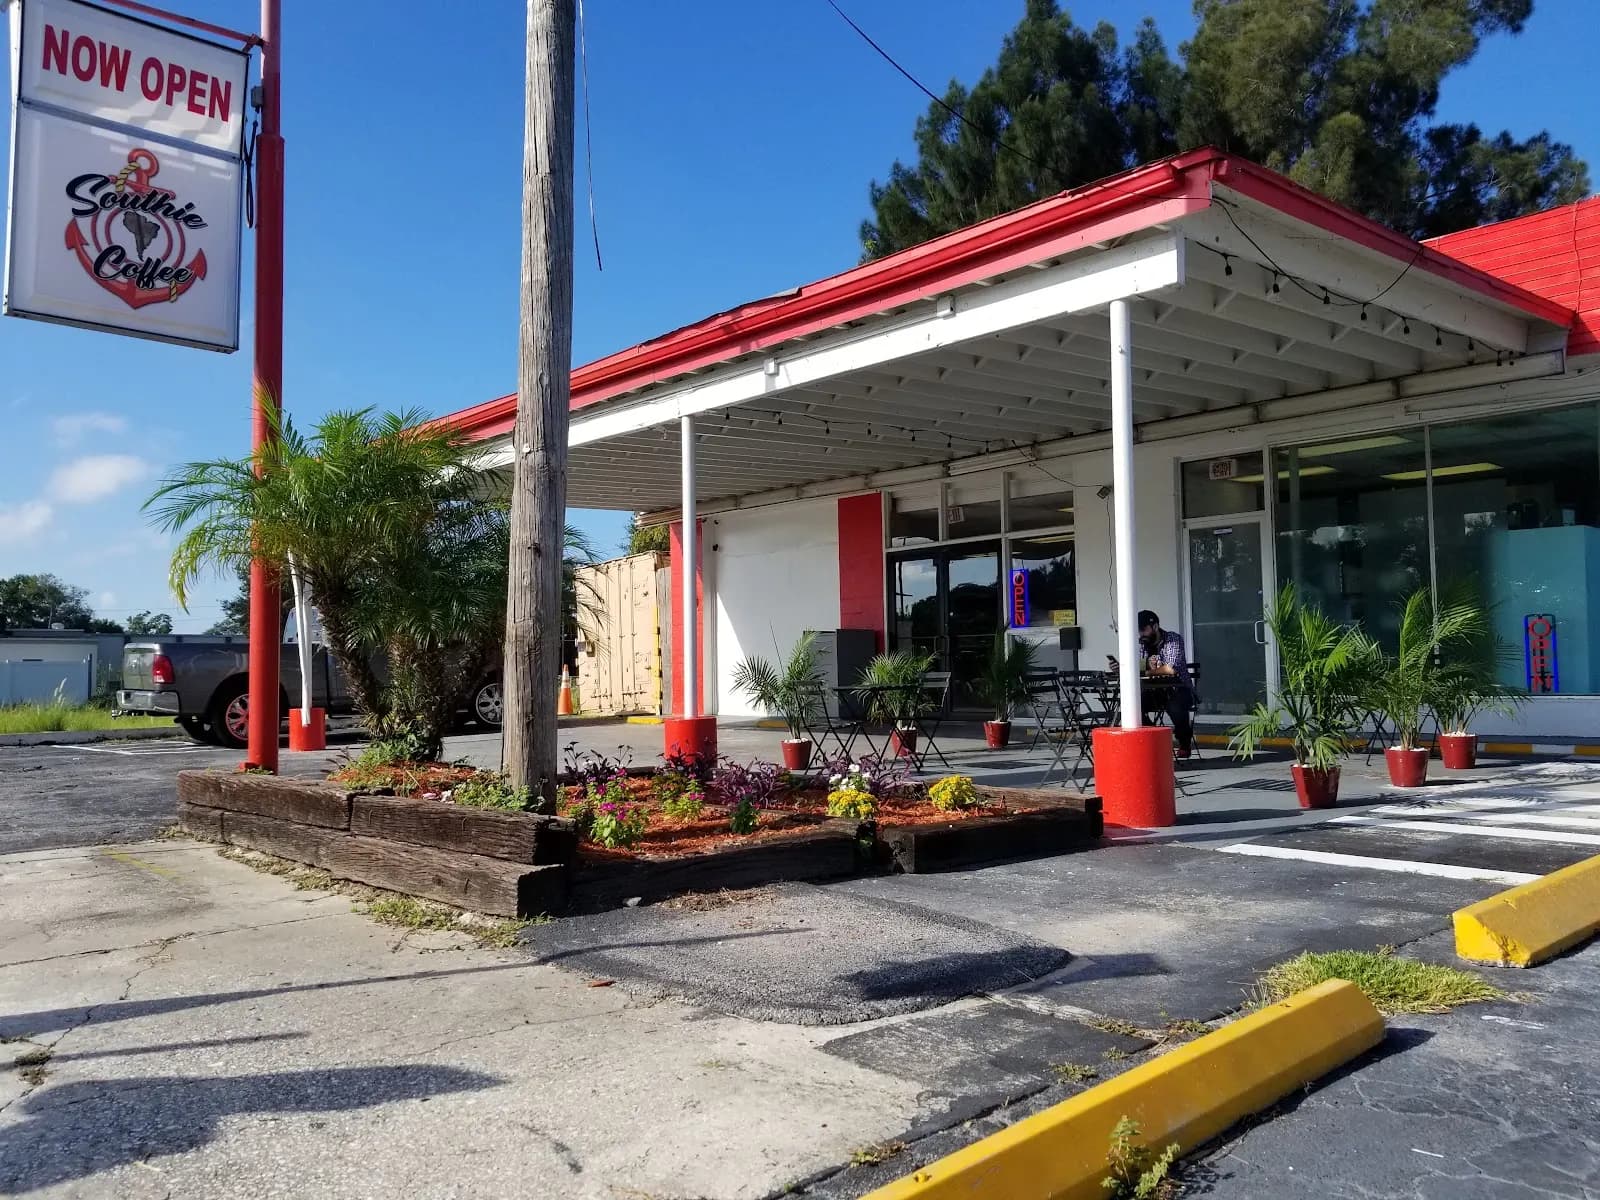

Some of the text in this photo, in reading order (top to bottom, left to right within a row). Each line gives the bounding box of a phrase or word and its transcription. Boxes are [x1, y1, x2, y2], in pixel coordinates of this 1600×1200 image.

[42, 24, 232, 122] NOW OPEN
[65, 173, 208, 230] Southie
[93, 244, 194, 290] Coffee
[1013, 572, 1025, 626] OPEN
[1528, 617, 1552, 692] OPEN
